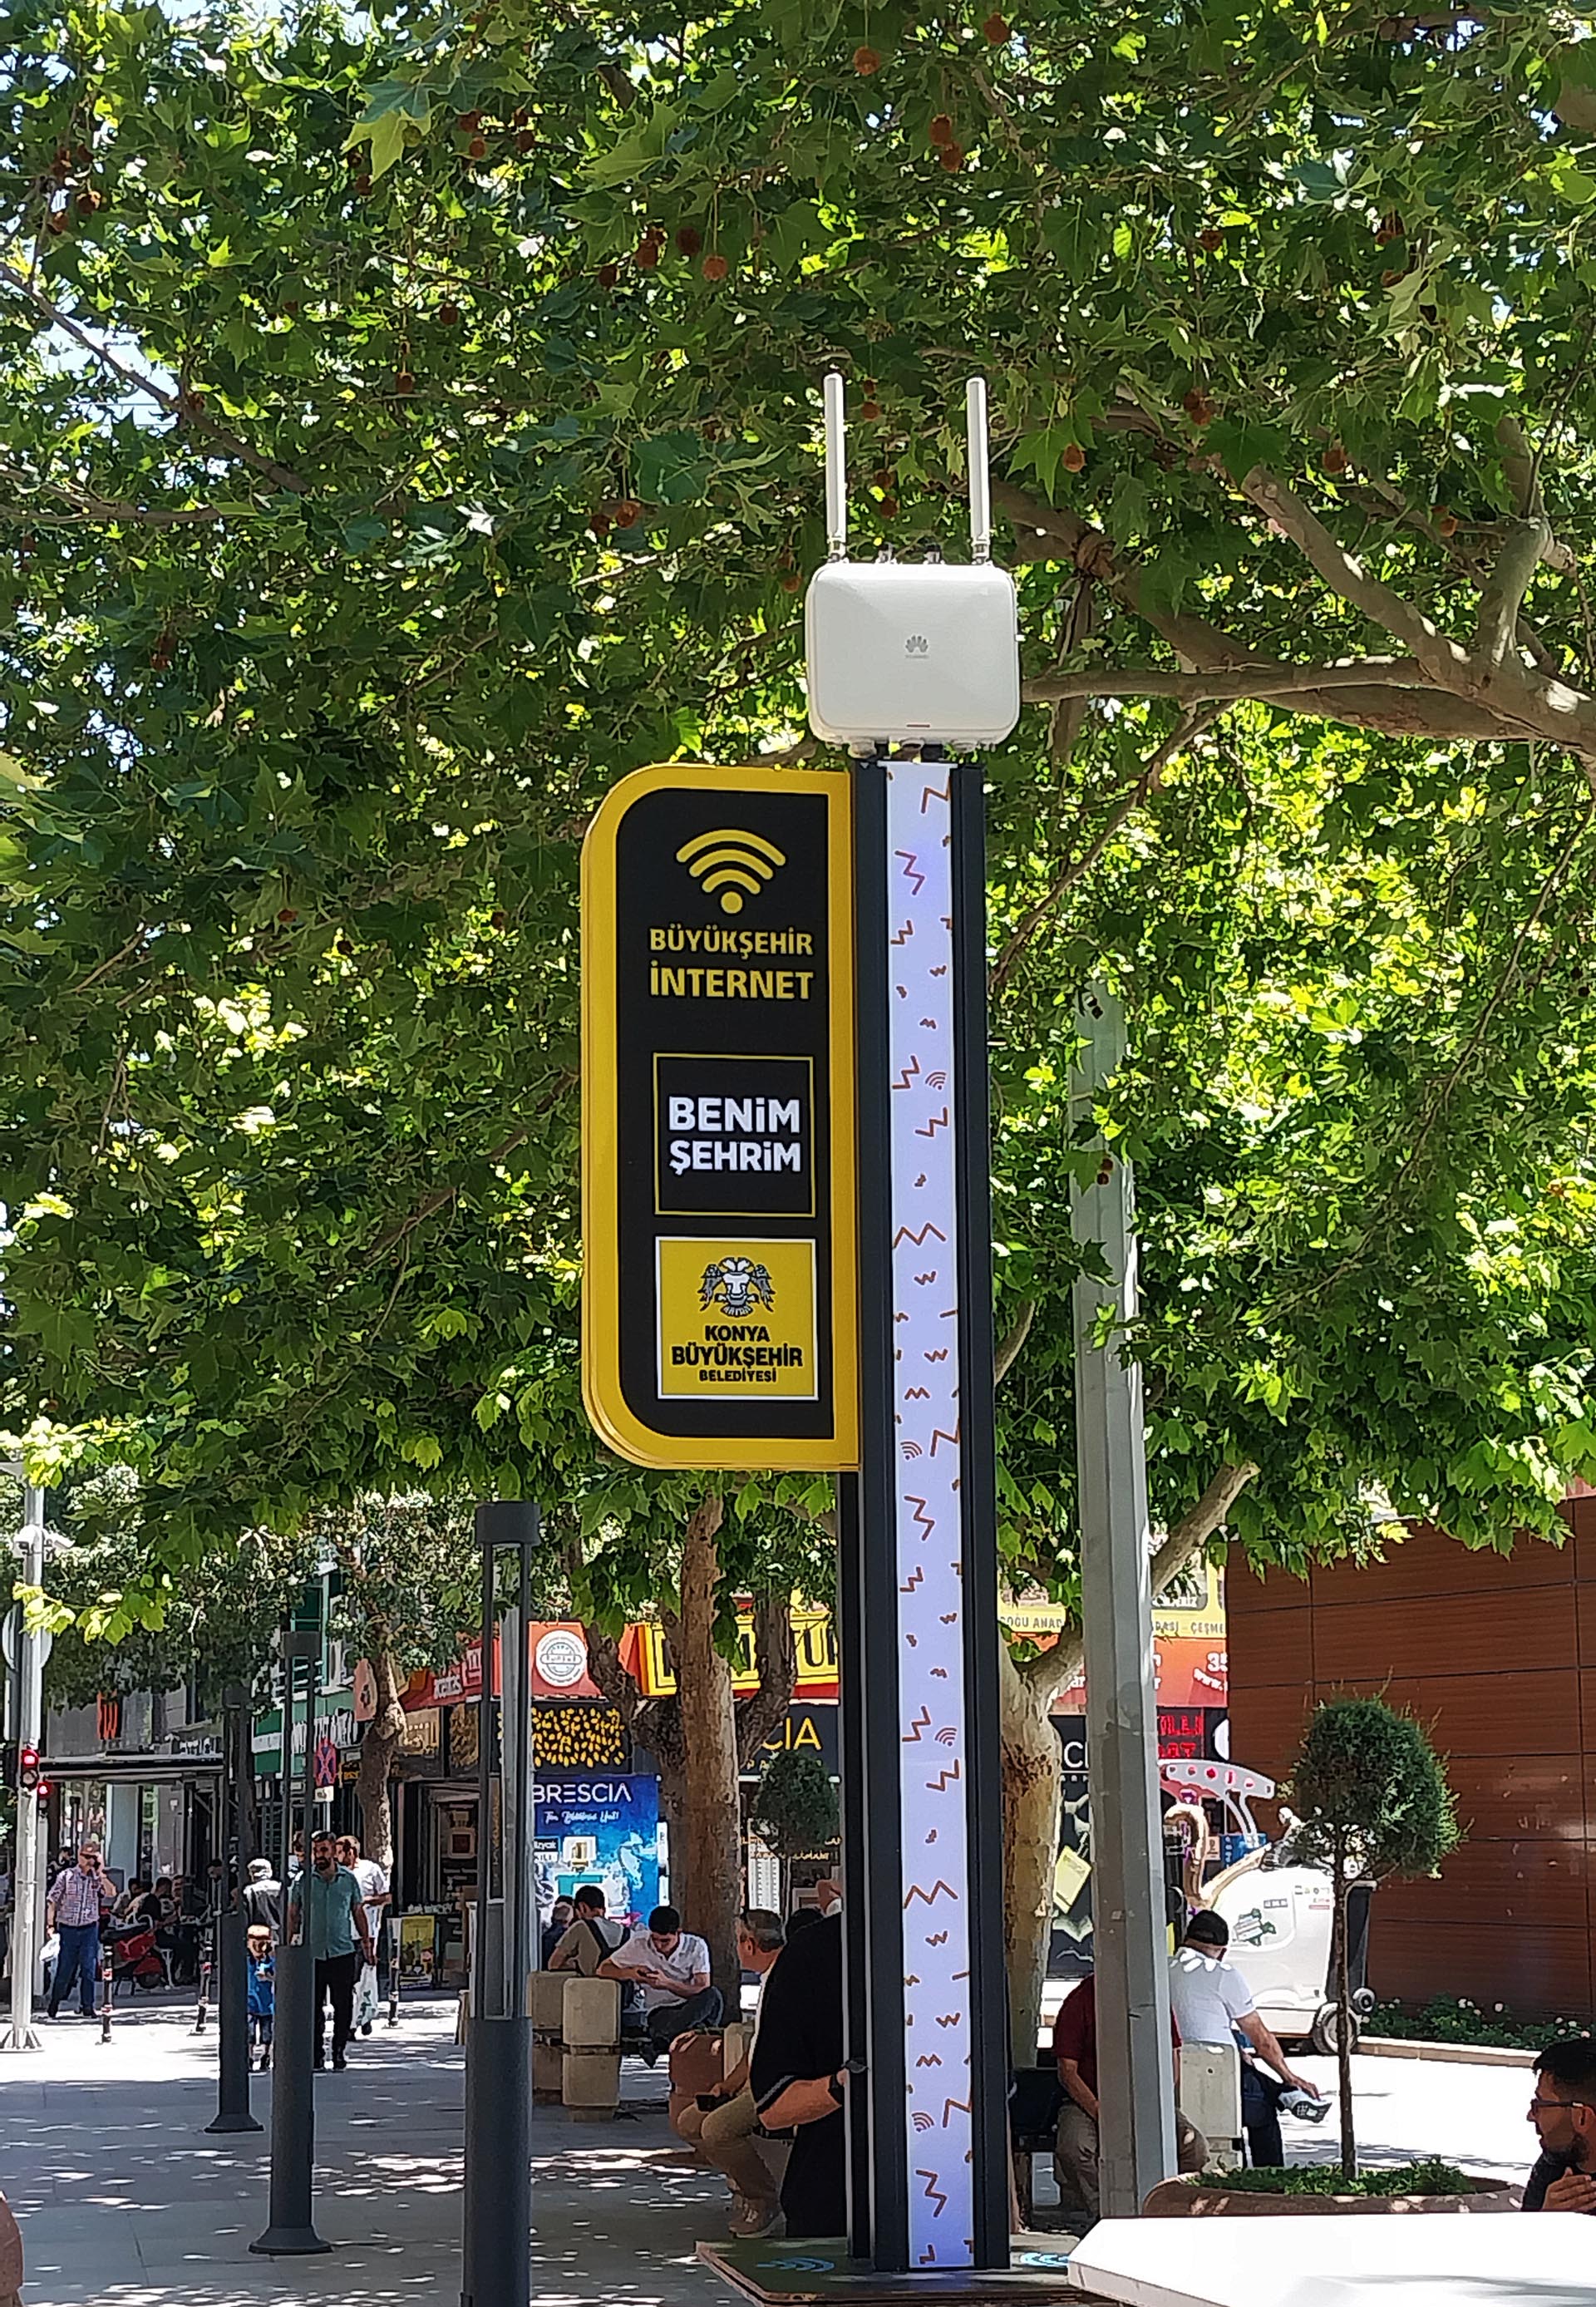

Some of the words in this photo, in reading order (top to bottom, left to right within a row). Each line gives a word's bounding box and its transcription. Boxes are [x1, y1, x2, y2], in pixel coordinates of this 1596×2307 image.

[649, 923, 813, 959] BÜYÜKŞEHİR
[650, 959, 814, 999] İNTERNET
[704, 1324, 771, 1342] KONYA
[671, 1341, 804, 1368] BÜYÜKŞEHİR
[698, 1367, 777, 1383] BELEDİYESİ
[533, 1782, 633, 1804] BRESCIA
